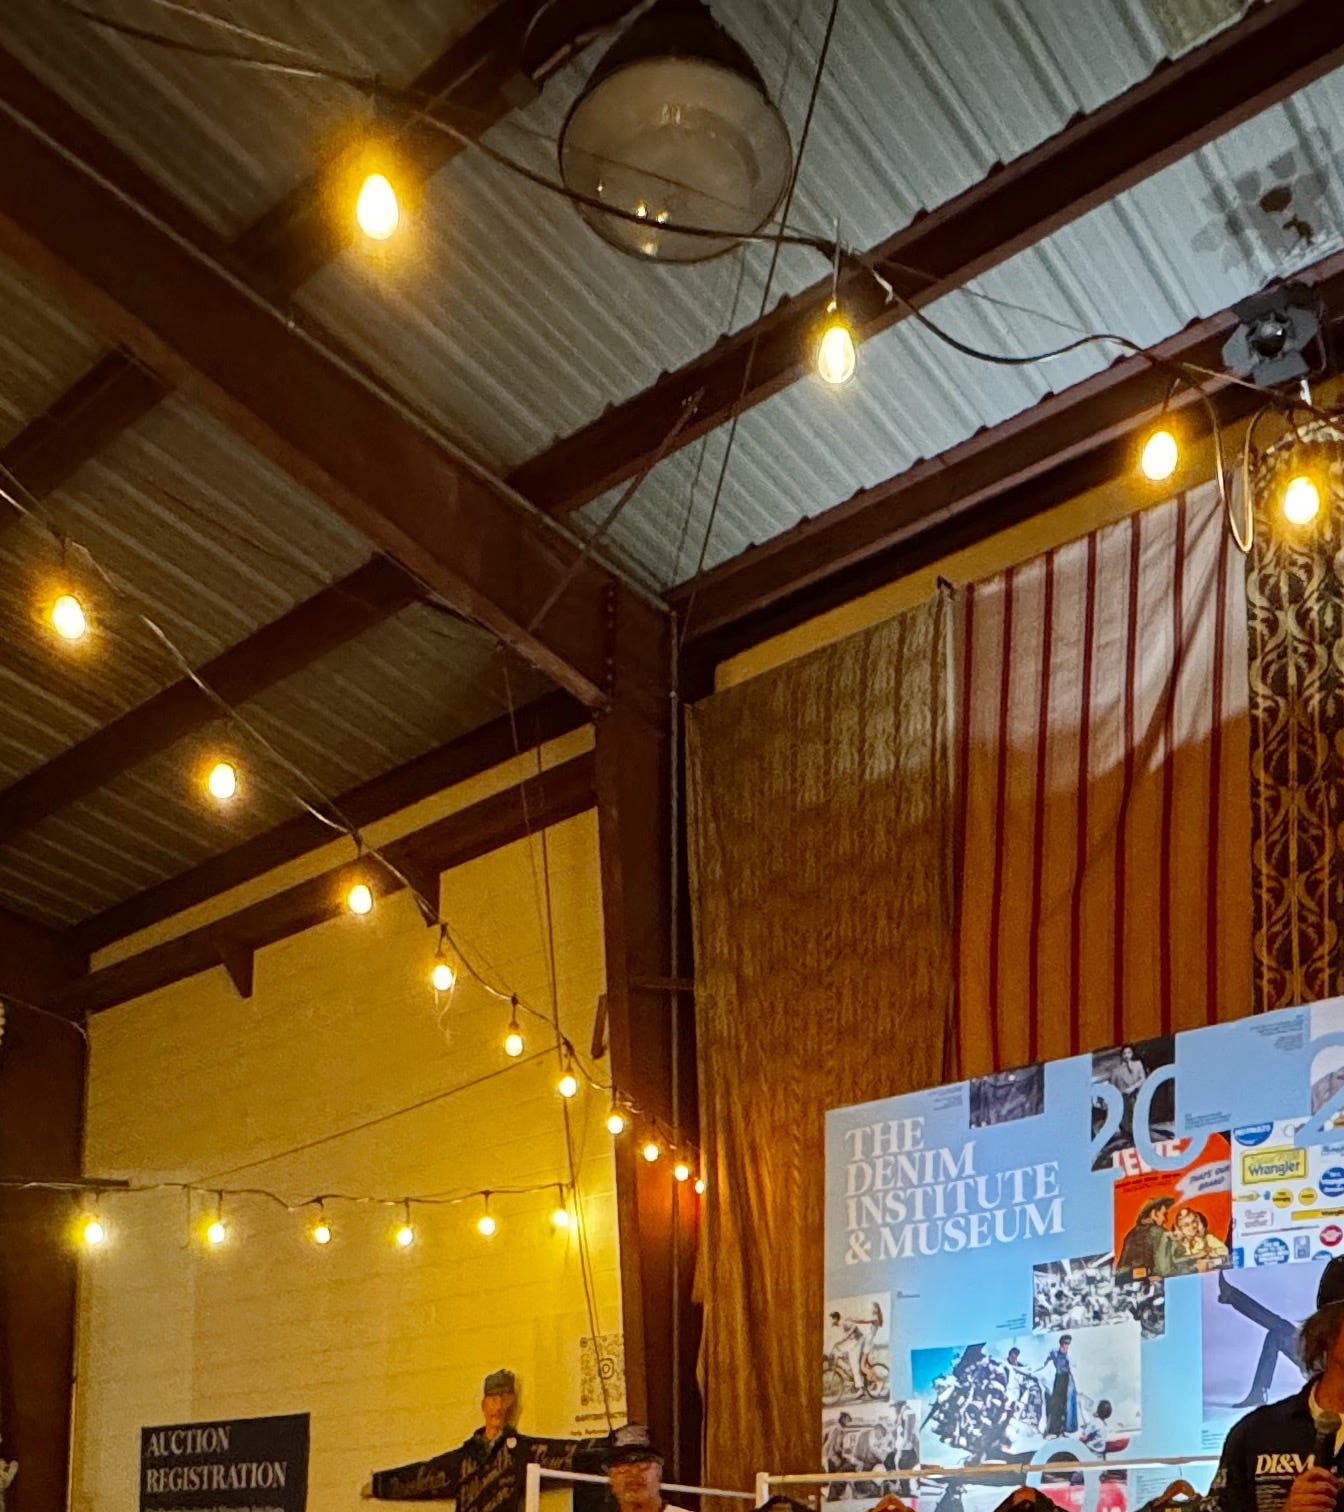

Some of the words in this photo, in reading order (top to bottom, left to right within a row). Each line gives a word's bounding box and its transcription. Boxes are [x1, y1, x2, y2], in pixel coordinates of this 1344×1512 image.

[845, 1116, 925, 1161] THE
[846, 1141, 977, 1197] DENIM
[846, 1161, 1059, 1231] INSTITUTE
[845, 1229, 872, 1265] &
[878, 1198, 1065, 1261] MUSEUM
[146, 1426, 232, 1457] AUCTION
[1256, 1453, 1316, 1474] DI&M
[146, 1461, 287, 1493] REGISTRATION
